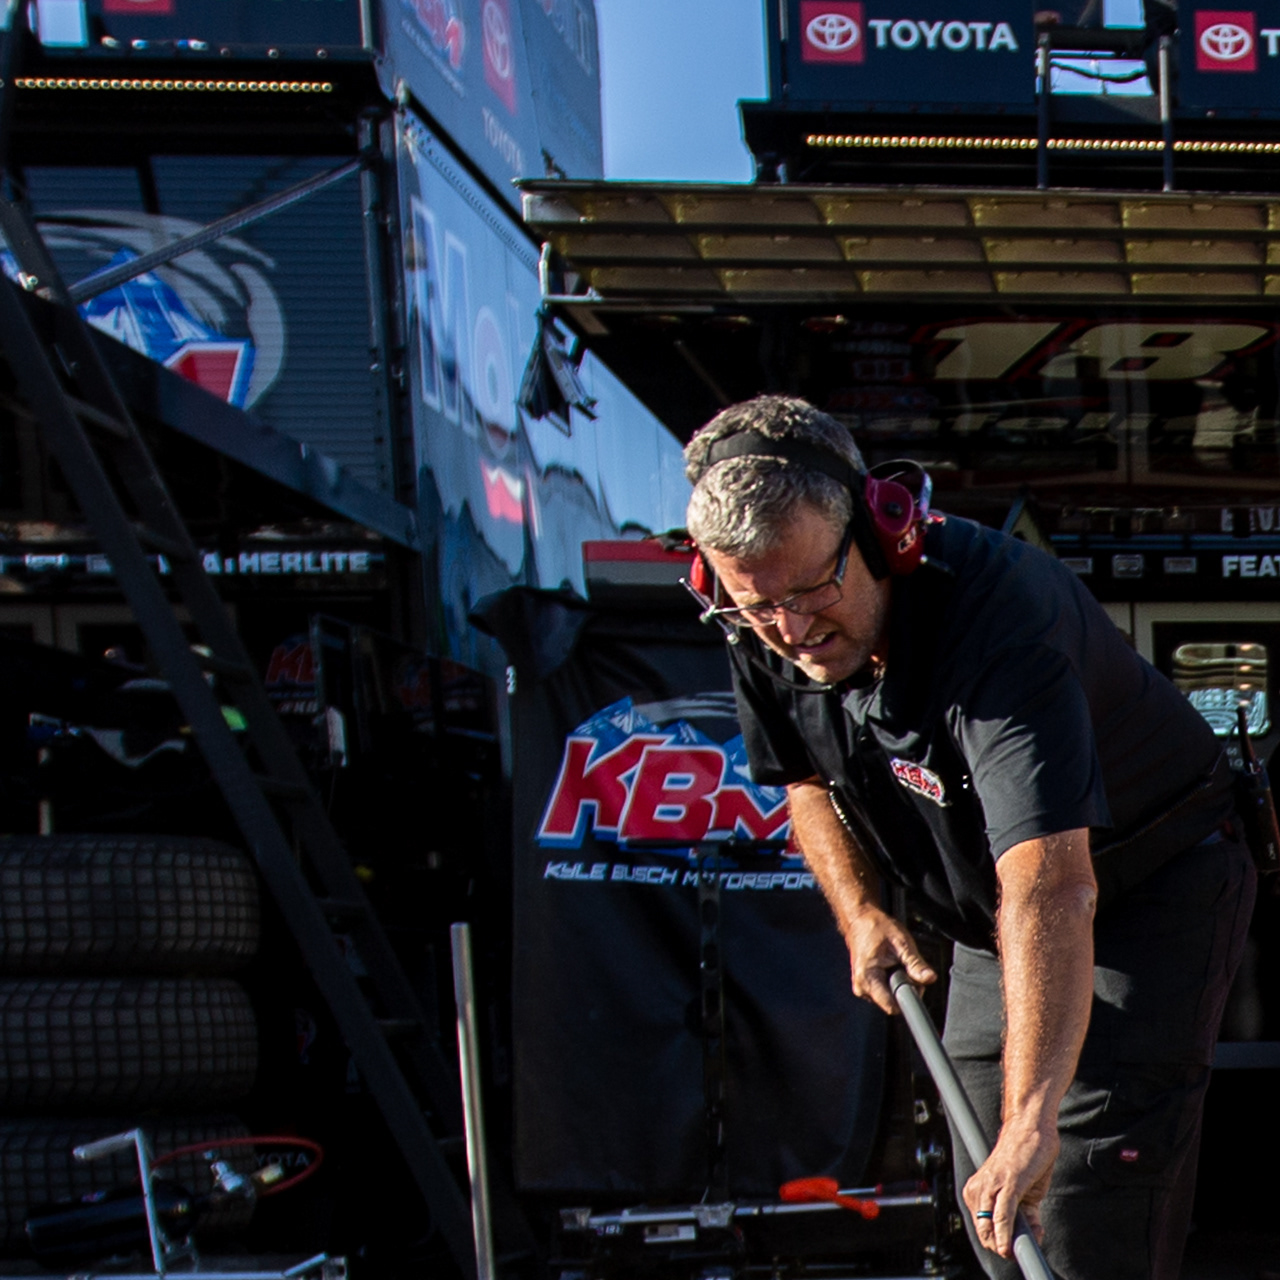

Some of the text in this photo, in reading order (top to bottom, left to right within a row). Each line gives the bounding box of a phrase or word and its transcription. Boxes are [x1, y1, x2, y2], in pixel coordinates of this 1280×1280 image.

[867, 19, 1018, 52] TOYOTA
[537, 732, 802, 858] KBM
[543, 861, 609, 881] KYLE
[610, 864, 678, 886] BUSCH
